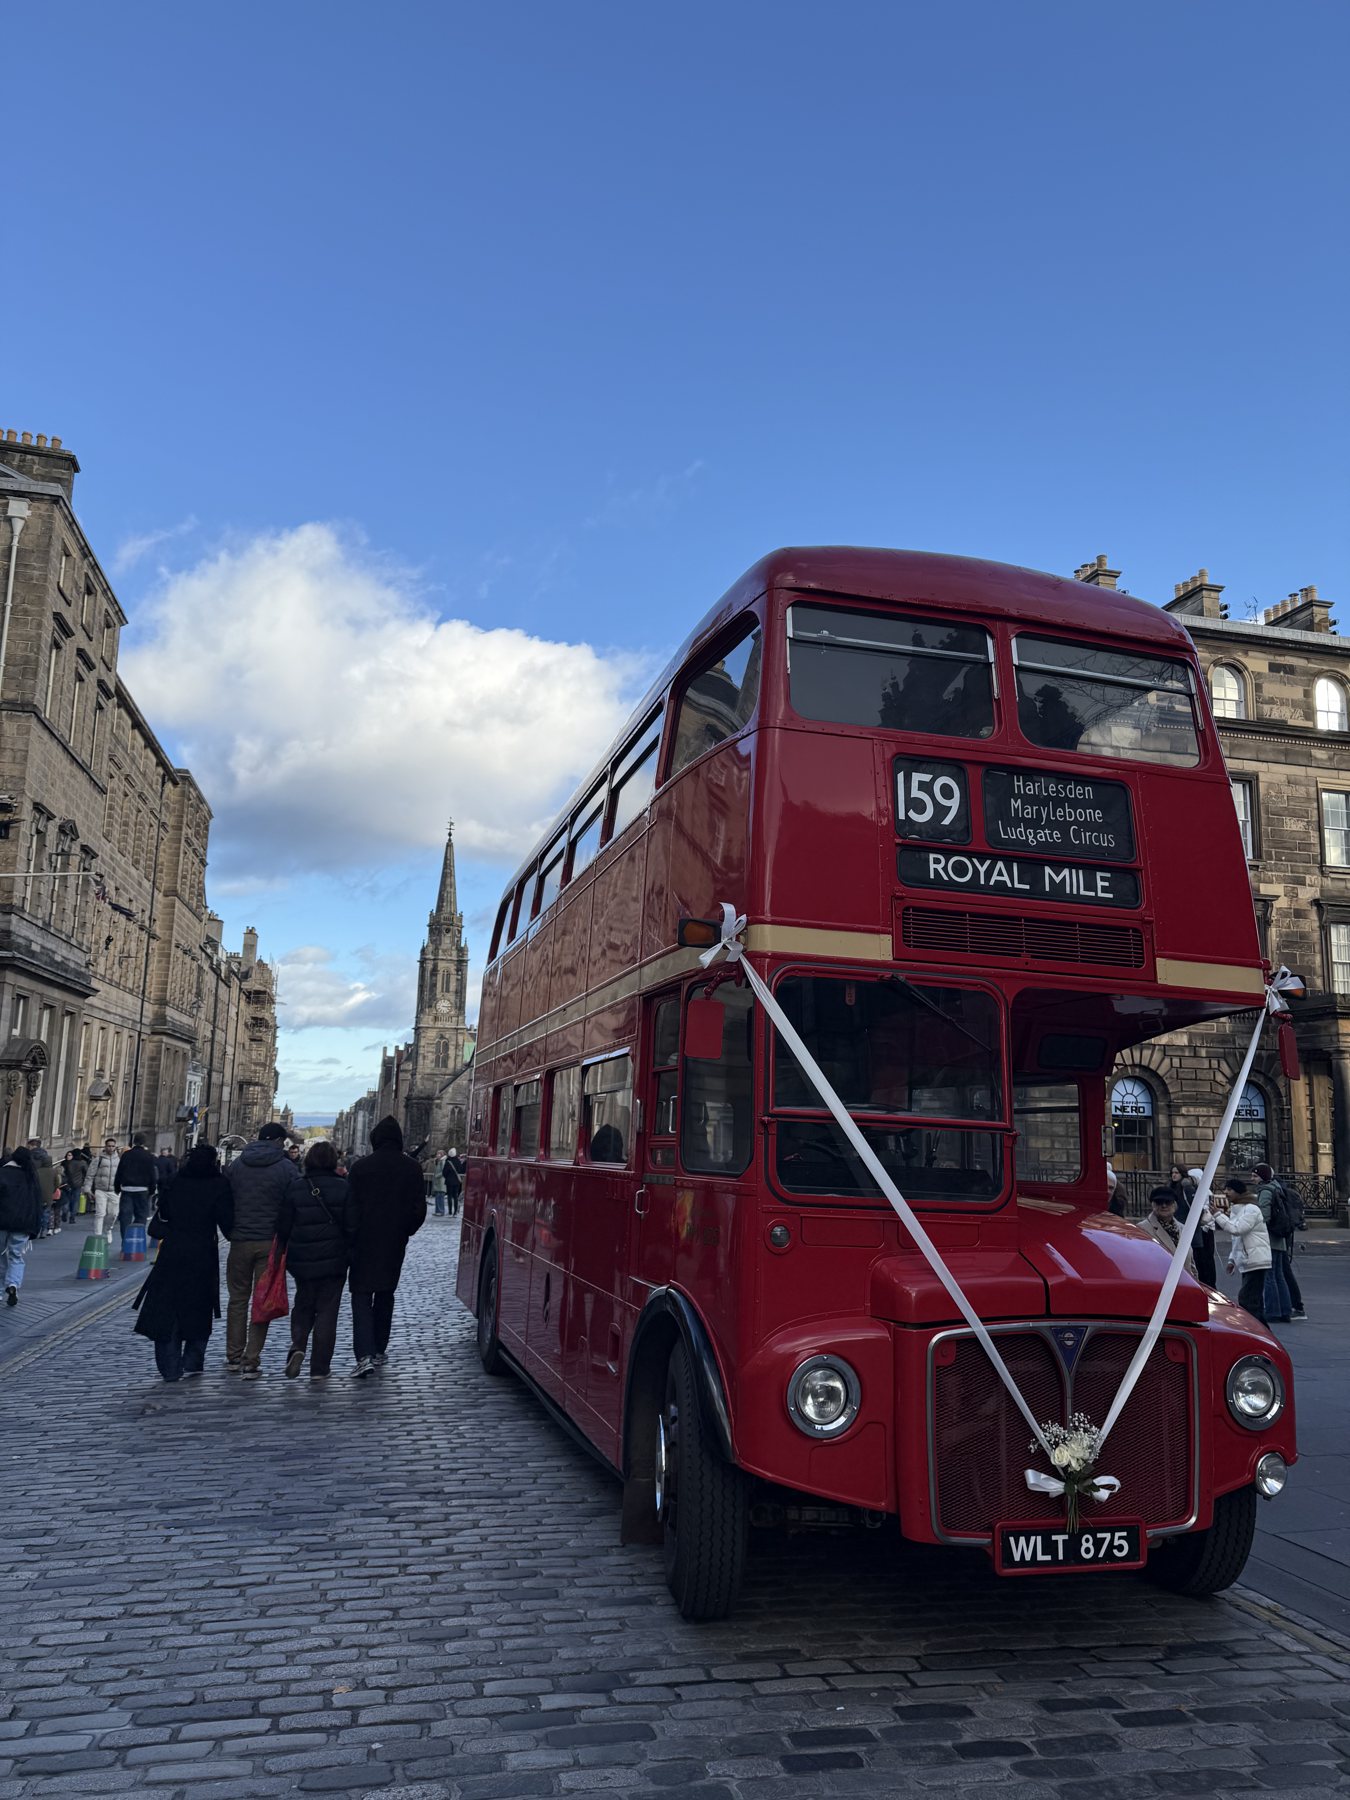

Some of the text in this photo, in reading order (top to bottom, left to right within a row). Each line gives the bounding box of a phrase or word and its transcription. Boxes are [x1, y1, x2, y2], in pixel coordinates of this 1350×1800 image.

[897, 771, 961, 826] 159
[1013, 775, 1094, 800] Harlesden
[1010, 798, 1104, 825] Marylebone
[998, 820, 1116, 848] Ludgate Circus
[928, 853, 1114, 899] ROYAL MILE
[1114, 1104, 1146, 1114] NERO
[1008, 1531, 1130, 1562] WLT 875
